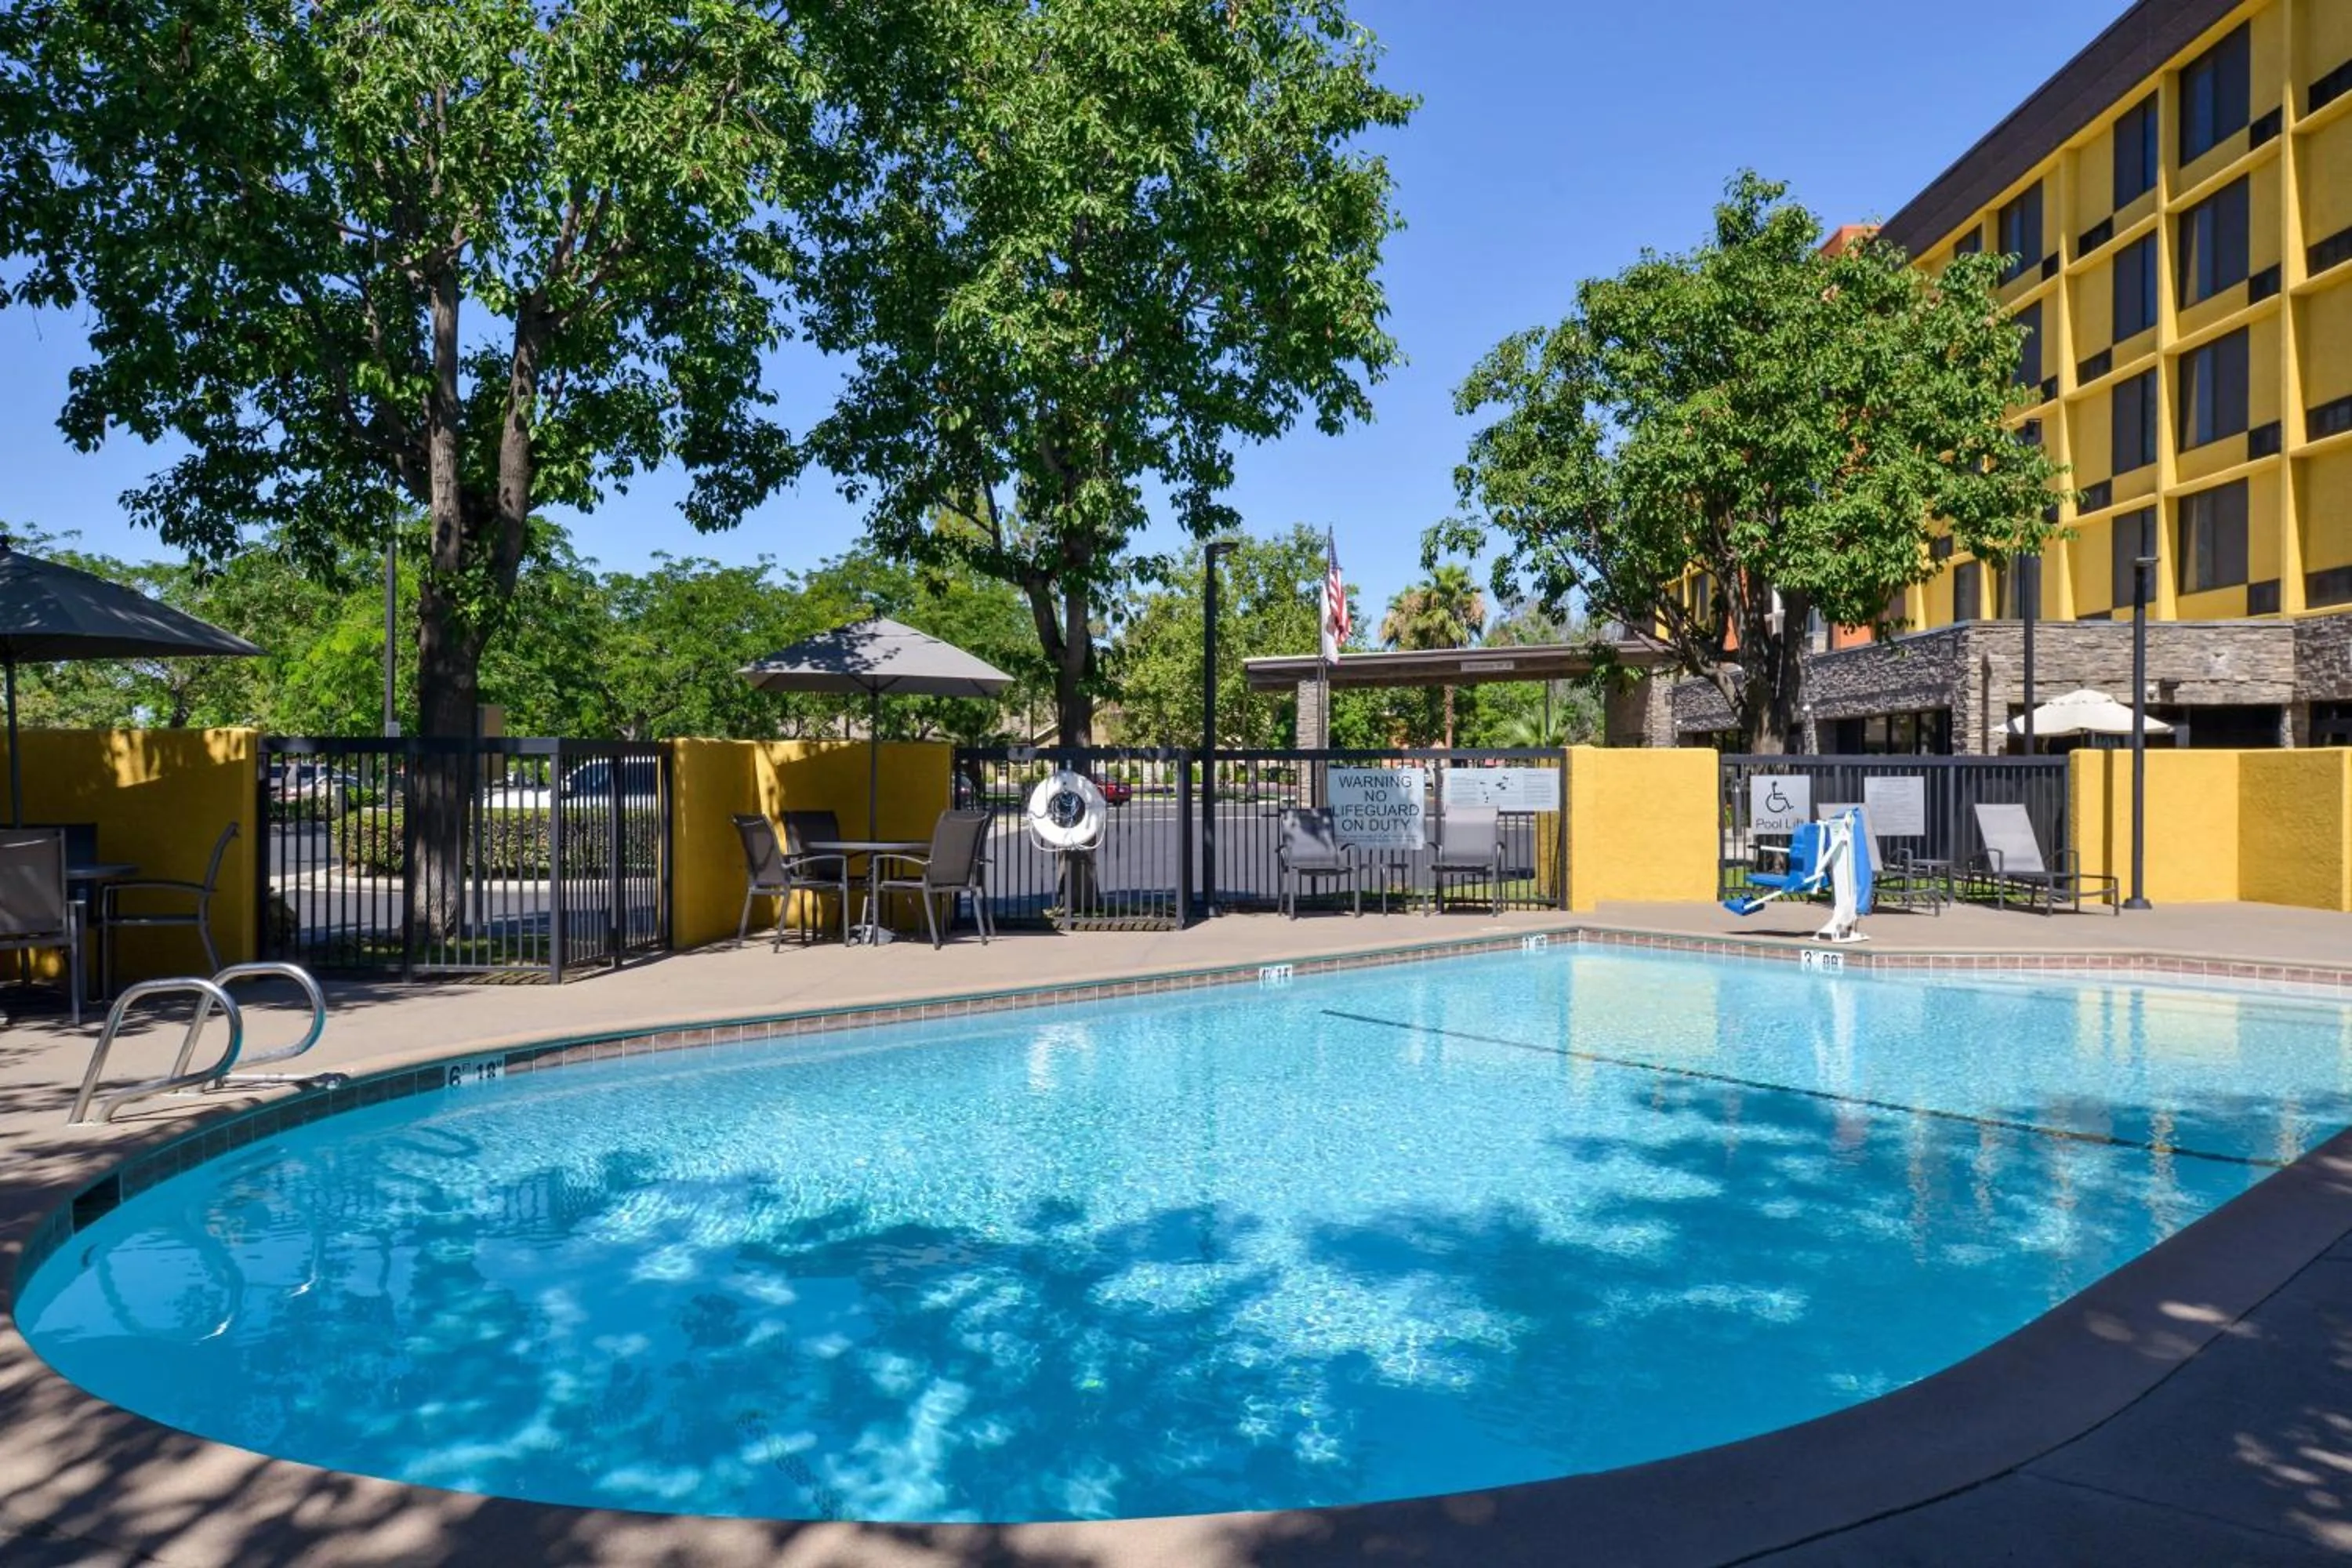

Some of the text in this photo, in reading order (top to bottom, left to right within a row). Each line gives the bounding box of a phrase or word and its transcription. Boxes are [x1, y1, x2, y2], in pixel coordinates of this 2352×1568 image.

[1338, 775, 1412, 788] WARNING
[1364, 789, 1387, 802] NO
[1332, 804, 1420, 817] LIFEGUARD
[1341, 818, 1411, 832] ON DUTY
[1755, 818, 1782, 829] Pool
